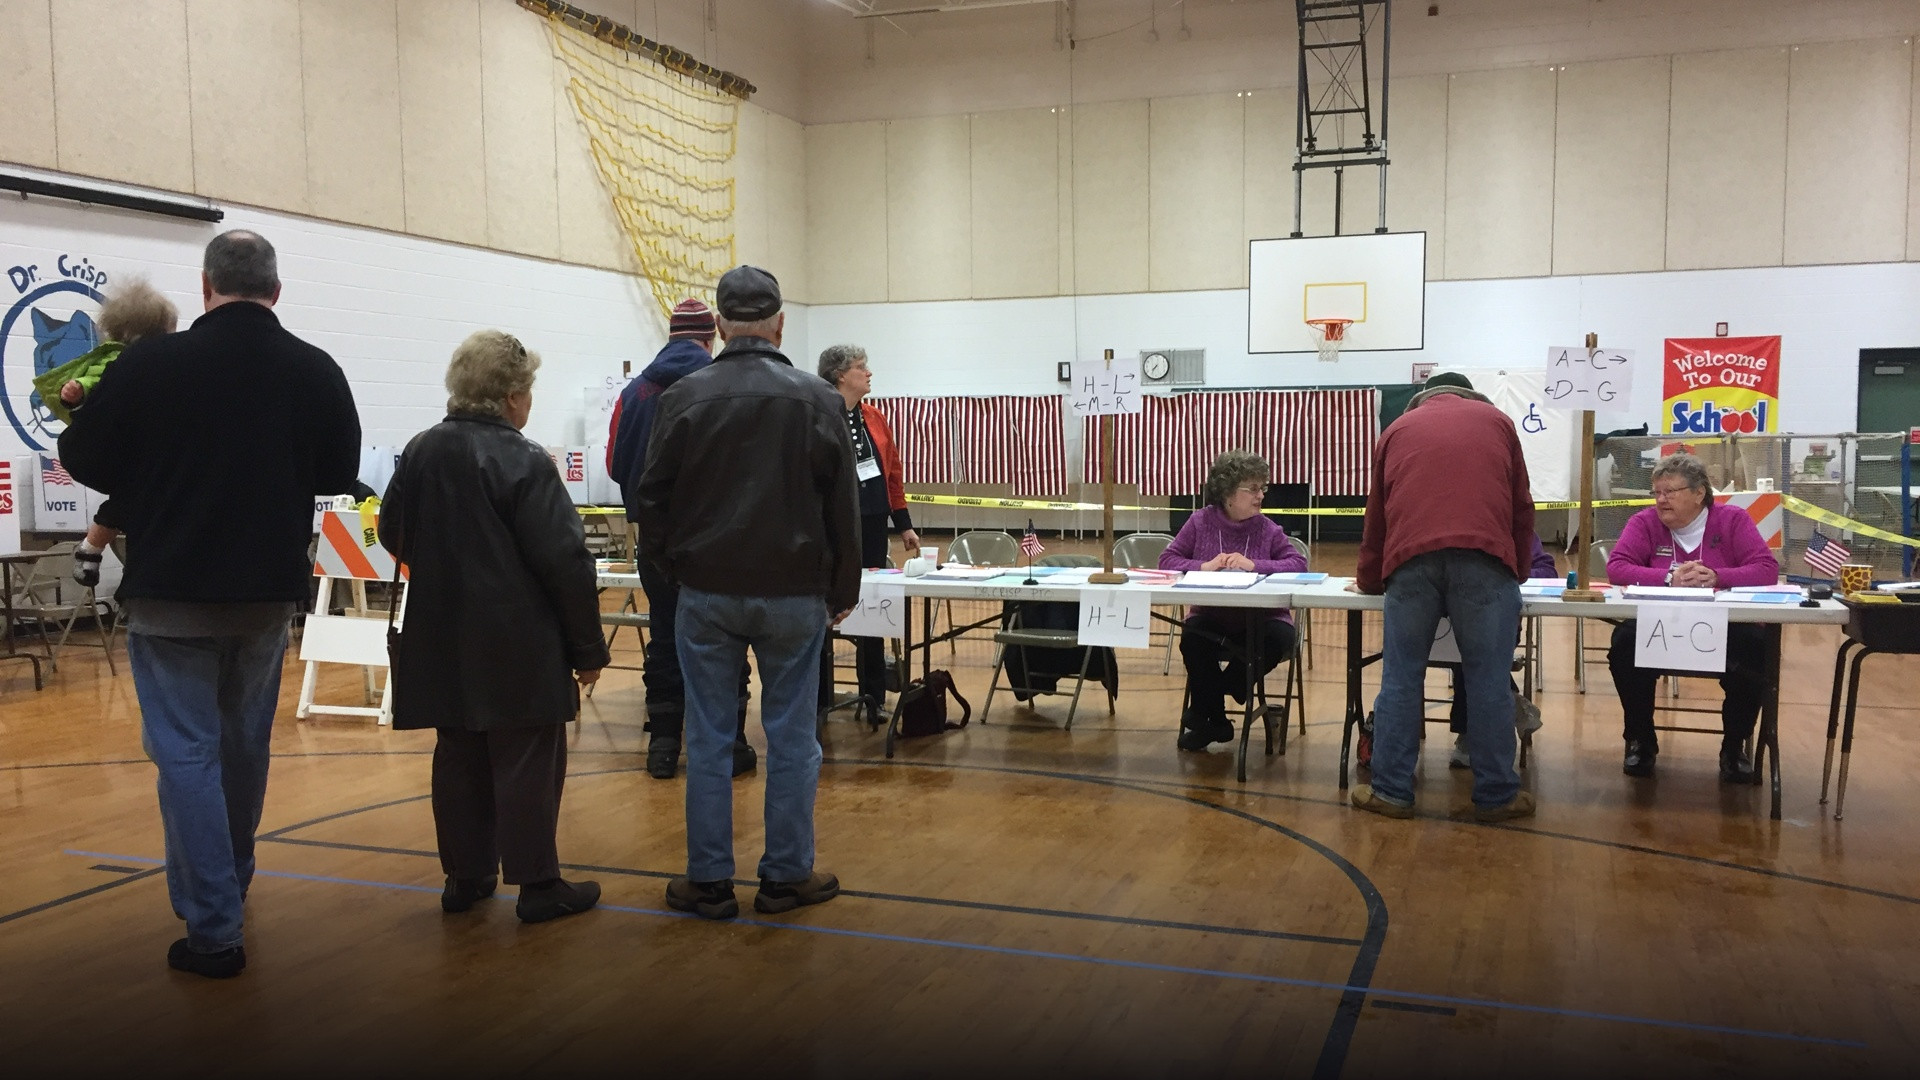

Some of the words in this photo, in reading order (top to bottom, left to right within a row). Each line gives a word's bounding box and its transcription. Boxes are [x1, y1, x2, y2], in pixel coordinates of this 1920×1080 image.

[7, 264, 41, 294] Dr.
[57, 253, 107, 289] Crisp
[1672, 350, 1767, 373] Welcome
[1683, 372, 1711, 389] To
[1720, 368, 1761, 387] Our
[46, 501, 76, 511] VOTE
